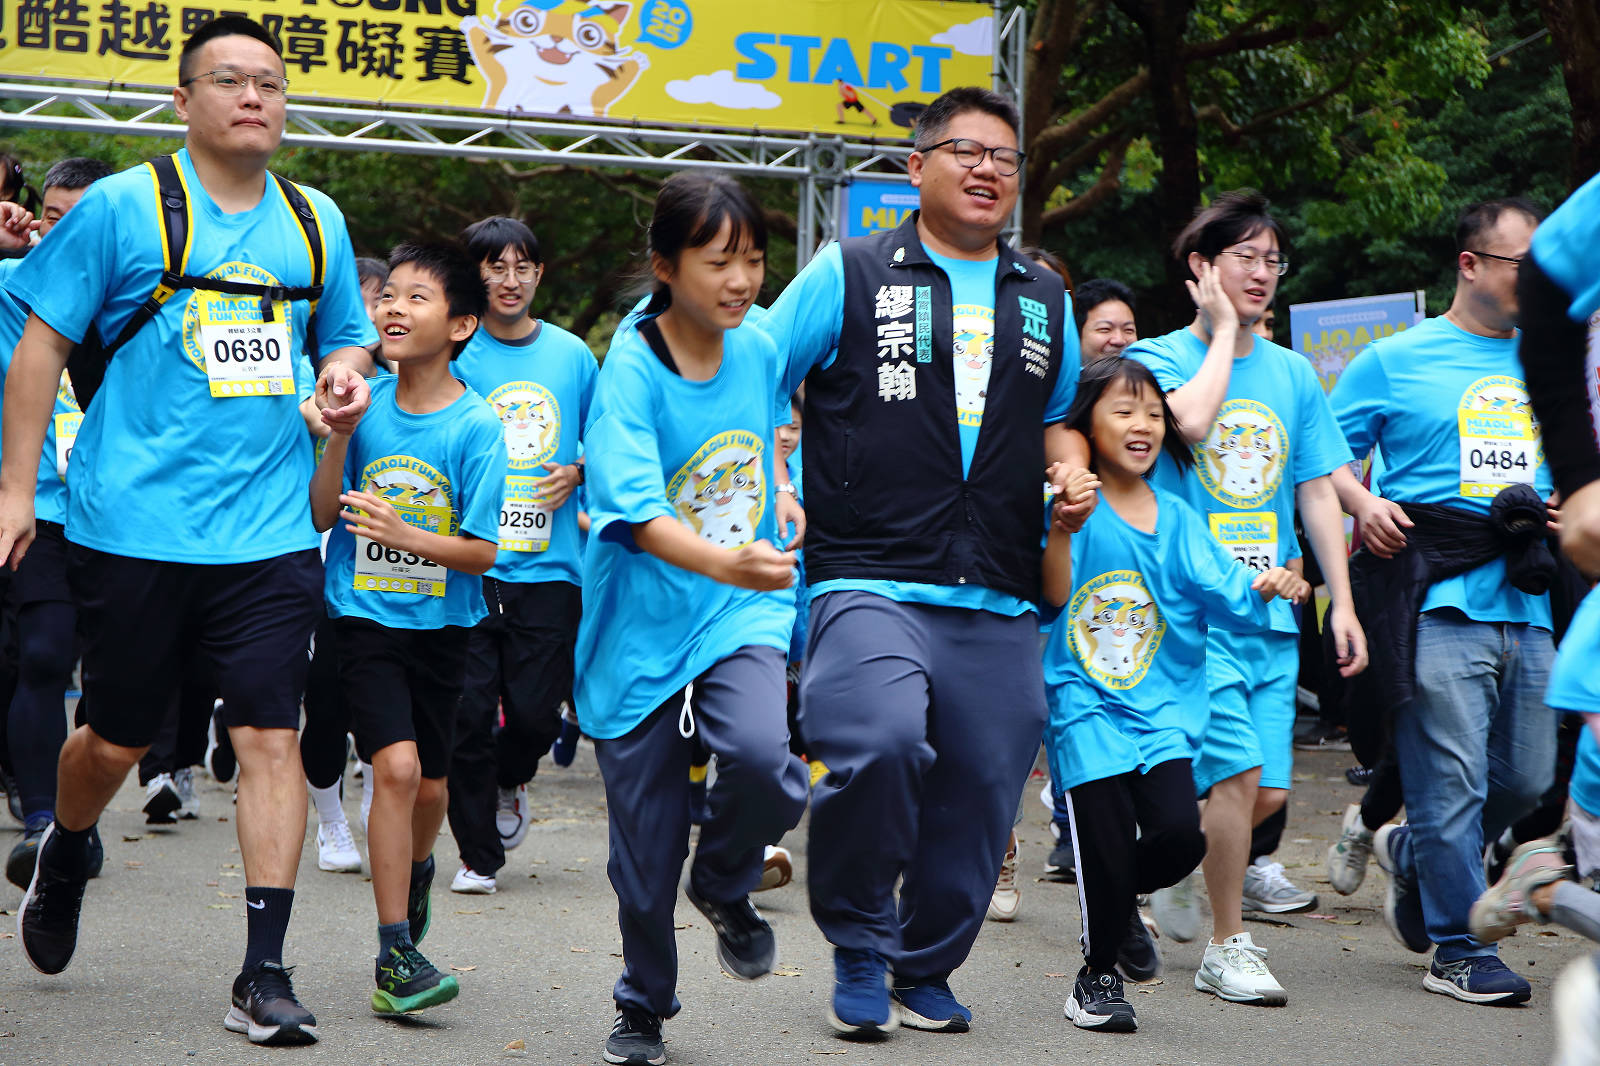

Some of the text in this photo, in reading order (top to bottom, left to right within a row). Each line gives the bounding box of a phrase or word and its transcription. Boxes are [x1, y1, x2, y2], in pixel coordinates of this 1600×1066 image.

[734, 32, 952, 93] START
[208, 312, 233, 321] FUN
[214, 338, 280, 363] 0630
[875, 285, 917, 402] 繆宗翰
[365, 458, 409, 478] MIAOLI
[411, 462, 437, 480] FUN
[1470, 449, 1528, 470] 0484
[400, 512, 427, 525] OLI
[499, 511, 546, 528] 0250
